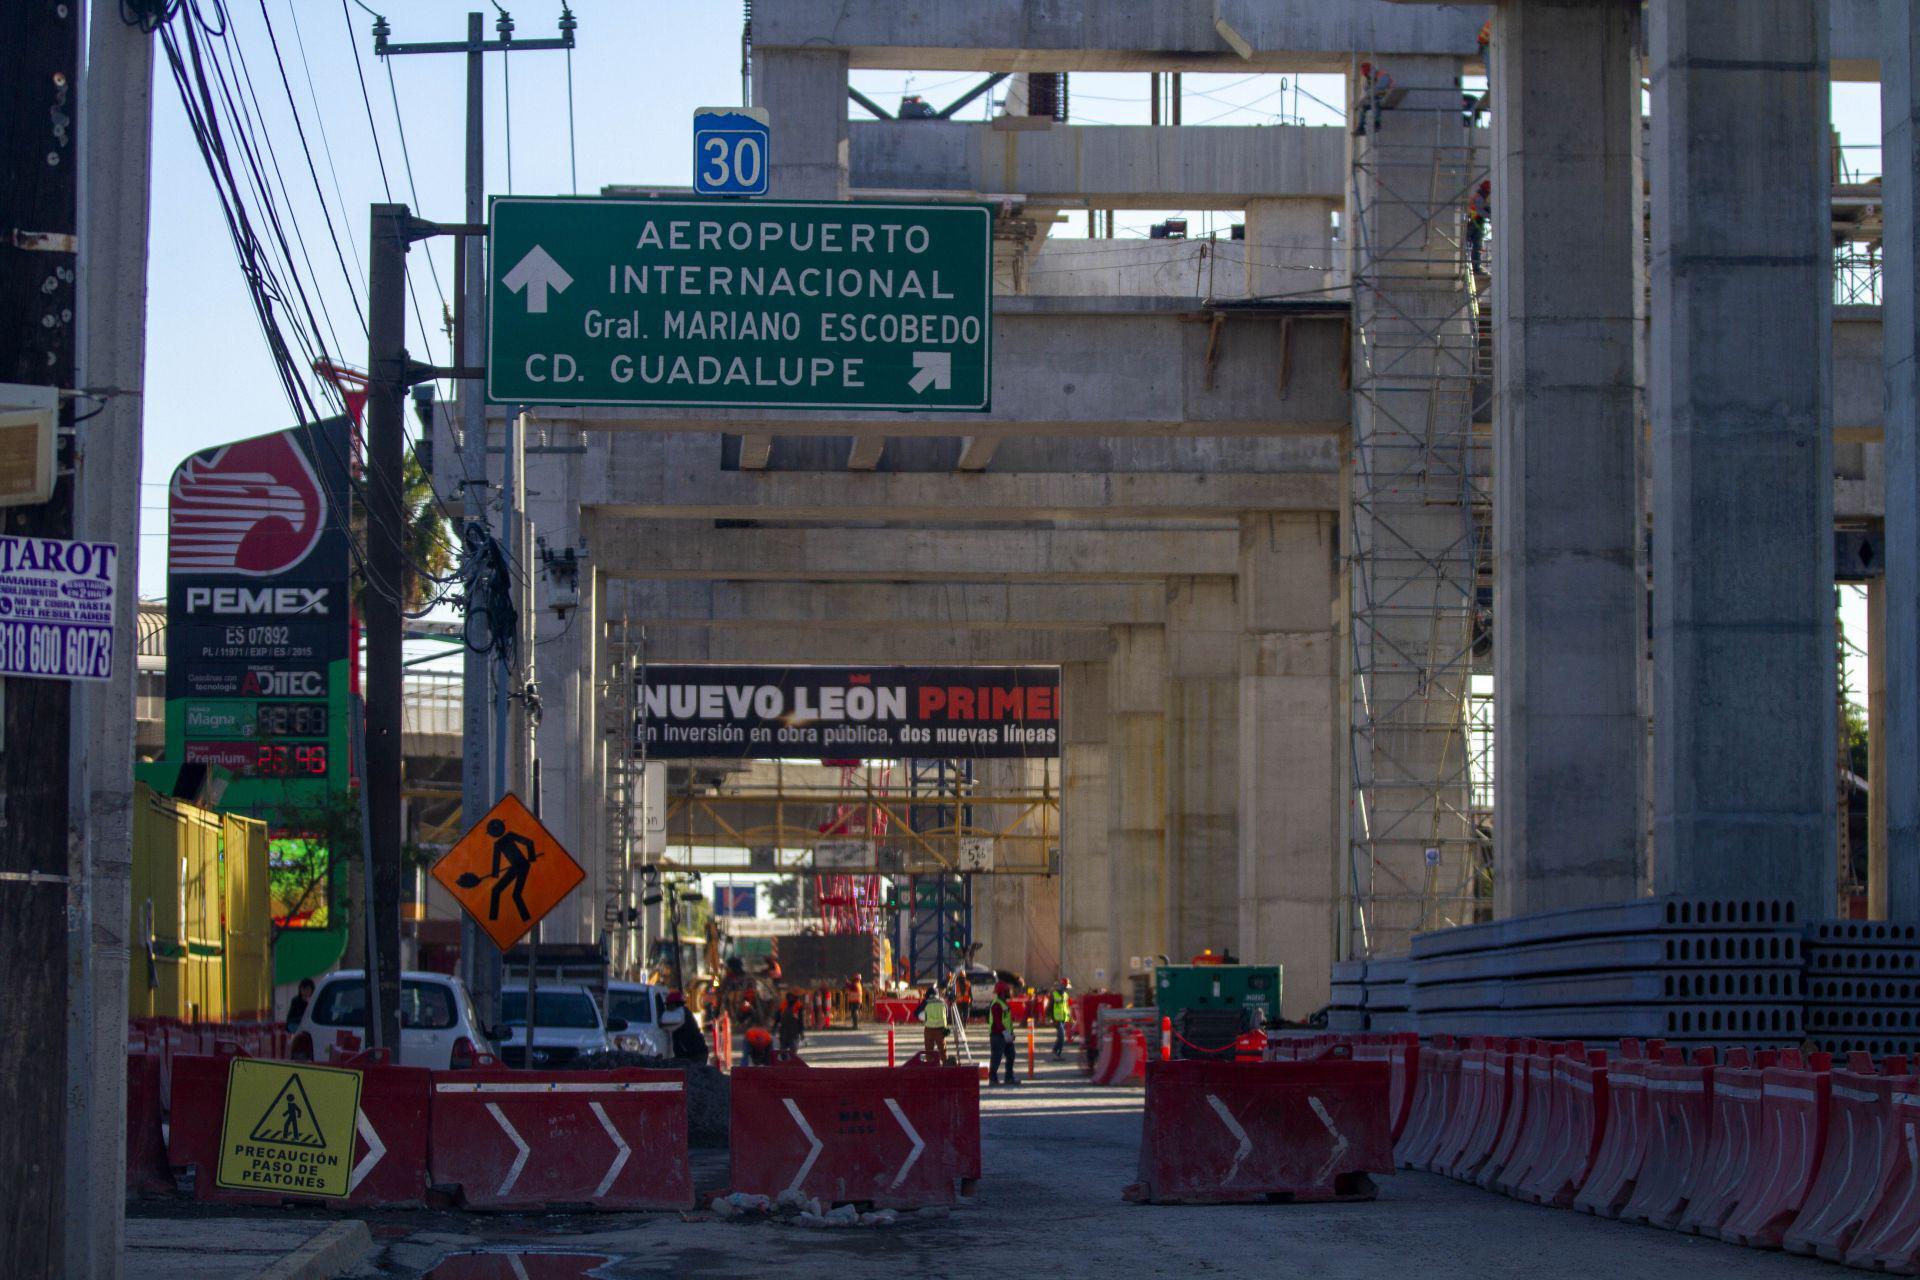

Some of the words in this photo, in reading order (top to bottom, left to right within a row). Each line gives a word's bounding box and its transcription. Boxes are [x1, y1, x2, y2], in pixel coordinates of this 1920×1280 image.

[702, 137, 762, 188] 30
[635, 220, 931, 254] AEROPUERTO
[609, 264, 955, 300] INTERNACIONAL
[584, 310, 649, 341] Gral.
[664, 311, 801, 342] MARIANO
[820, 313, 982, 345] ESCOBEDO
[525, 353, 585, 383] CD.
[610, 354, 865, 387] GUADALUPE
[0, 537, 118, 581] TAROT
[186, 587, 329, 614] PEMEX
[225, 625, 245, 645] ES
[248, 625, 289, 645] 07892
[30, 623, 62, 674] 600
[65, 626, 111, 678] 6073
[250, 647, 268, 657] EXP
[637, 684, 784, 720] NUEVO
[187, 711, 236, 729] Magna
[664, 723, 744, 742] inversión
[751, 728, 771, 742] en
[777, 725, 819, 743] obra
[824, 723, 893, 745] pública,
[900, 724, 931, 743] dos
[937, 728, 999, 743] nuevas
[1003, 724, 1057, 743] líneas
[186, 751, 246, 764] Premium
[234, 1144, 338, 1166] PRECAUCIÓN
[252, 1159, 293, 1174] PASO
[298, 1164, 319, 1177] DE
[242, 1170, 326, 1189] PEATONES
